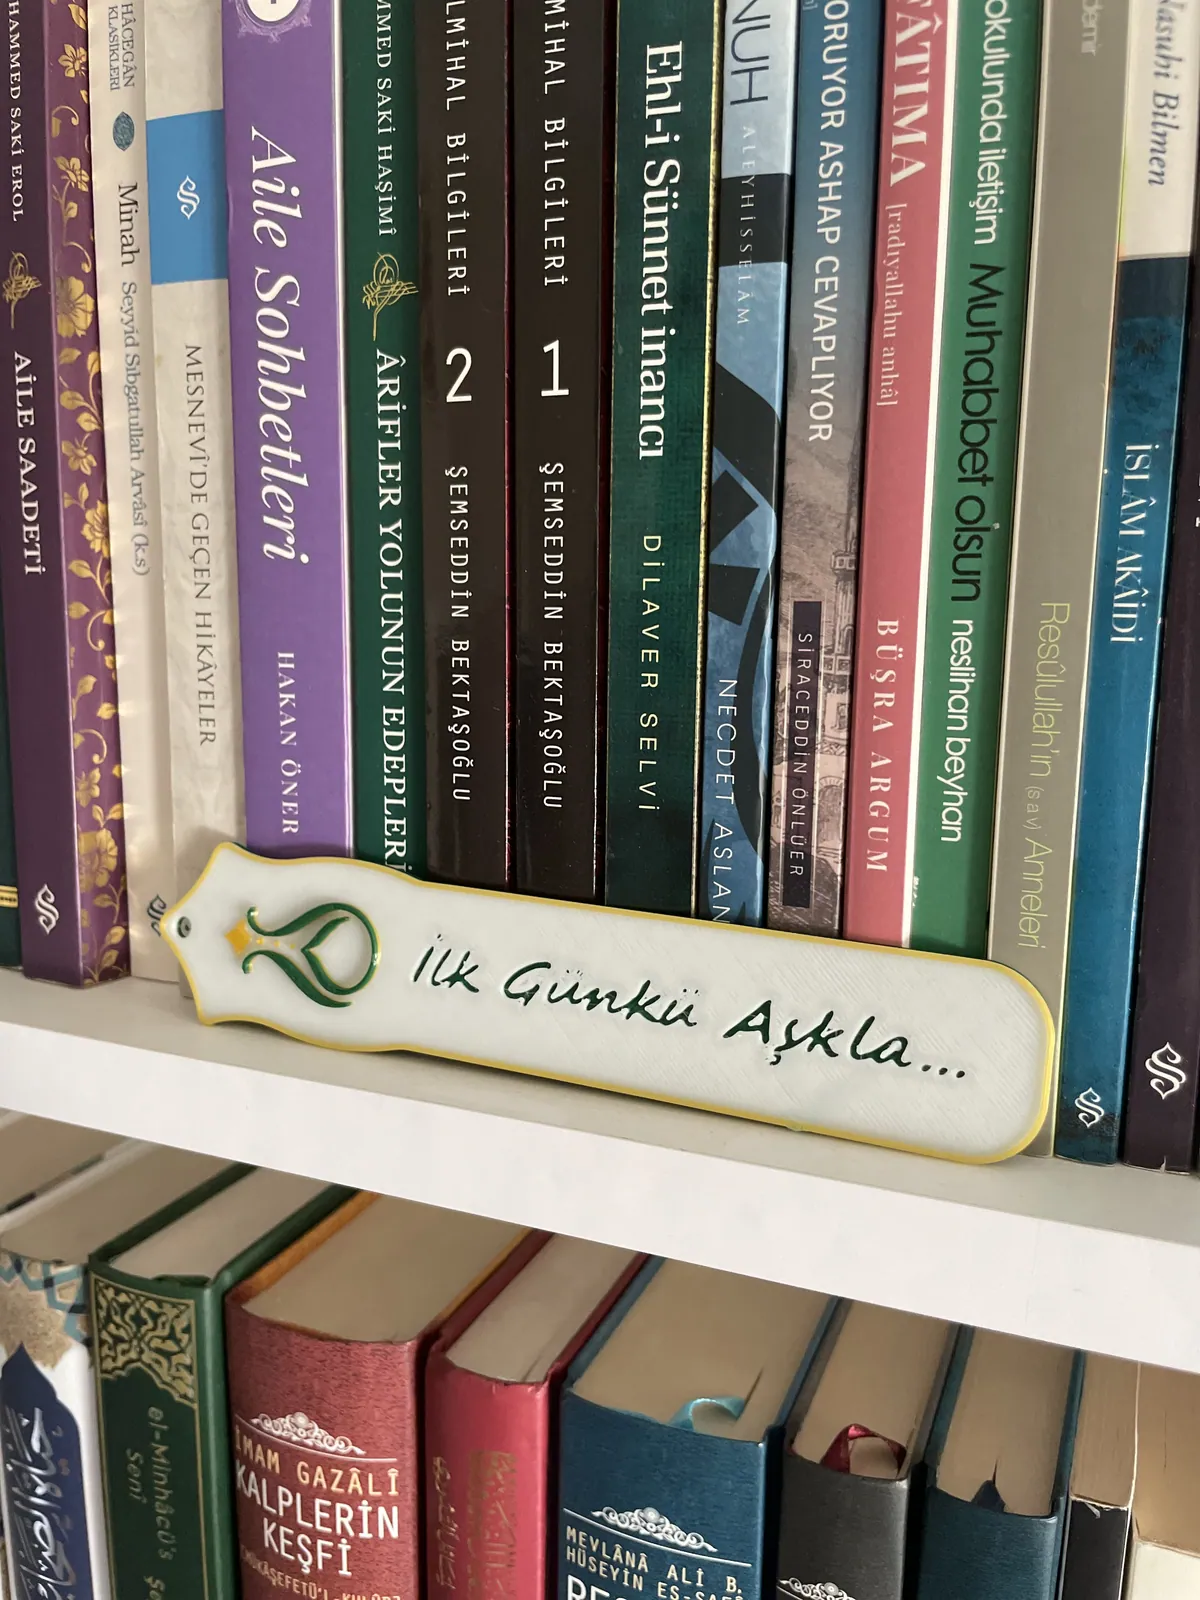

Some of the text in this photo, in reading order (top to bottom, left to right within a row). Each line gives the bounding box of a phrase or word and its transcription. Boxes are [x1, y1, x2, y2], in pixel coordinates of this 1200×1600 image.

[8, 1, 24, 221] HAMMED SAKİ EROL
[108, 6, 121, 91] KLASİKLERİ
[120, 2, 136, 88] HÂCEGÂN
[377, 78, 396, 134] SAKİ
[969, 0, 1013, 245] okulunda iletişim
[375, 144, 397, 236] HAŞİMÎ
[446, 0, 470, 296] LMİHAL BİLGİLERİ
[544, 0, 570, 287] MİHAL BİLGİLERİ
[1148, 90, 1180, 186] Bilmen
[118, 182, 140, 267] Minah
[638, 40, 683, 461] Ehl-i Sünnet inancı
[808, 0, 849, 442] ORUYOR ASHAP CEVAPLIYOR
[14, 351, 36, 428] AİLE
[120, 281, 140, 348] Seyyid
[130, 466, 148, 528] Arvâsî
[250, 125, 310, 564] Aile Sohbetleri
[446, 347, 472, 403] 2
[541, 339, 570, 397] 1
[17, 437, 46, 575] SAADETİ
[376, 348, 407, 510] ÂRİFLER
[951, 263, 1006, 602] Muhabbet olsun
[189, 513, 211, 600] GEÇEN
[379, 518, 405, 695] YOLUNUN
[1110, 443, 1160, 644] İSLÂM AKÂİDİ
[195, 611, 217, 746] HİKÂYELER
[445, 466, 474, 801] ŞEMSEDDİN BEKTAŞOĞLU
[539, 462, 567, 808] ŞEMSEDDİN BEKTAŞOĞLU
[638, 535, 665, 811] DİLAVER SELVİ
[277, 652, 302, 834] HAKAN ÖNER
[382, 705, 413, 872] EDEPLERİ
[712, 678, 738, 923] NECDET ASLAN
[789, 633, 815, 876] SİRACEDDİN ÖNLÜER
[865, 619, 904, 872] BÜŞRA ARGUM
[936, 619, 977, 842] neslihan beyhan
[1018, 837, 1053, 949] Anneleri
[412, 934, 967, 1080] İlk Günkü Aşkla...
[235, 1458, 399, 1540] KALPLERİN
[263, 1517, 352, 1577] KEŞFİ
[296, 1461, 399, 1497] GAZÂLÎ
[566, 1525, 743, 1594] MEVLÂNÂ ALİ B.
[566, 1545, 644, 1591] HÜSEYİN
